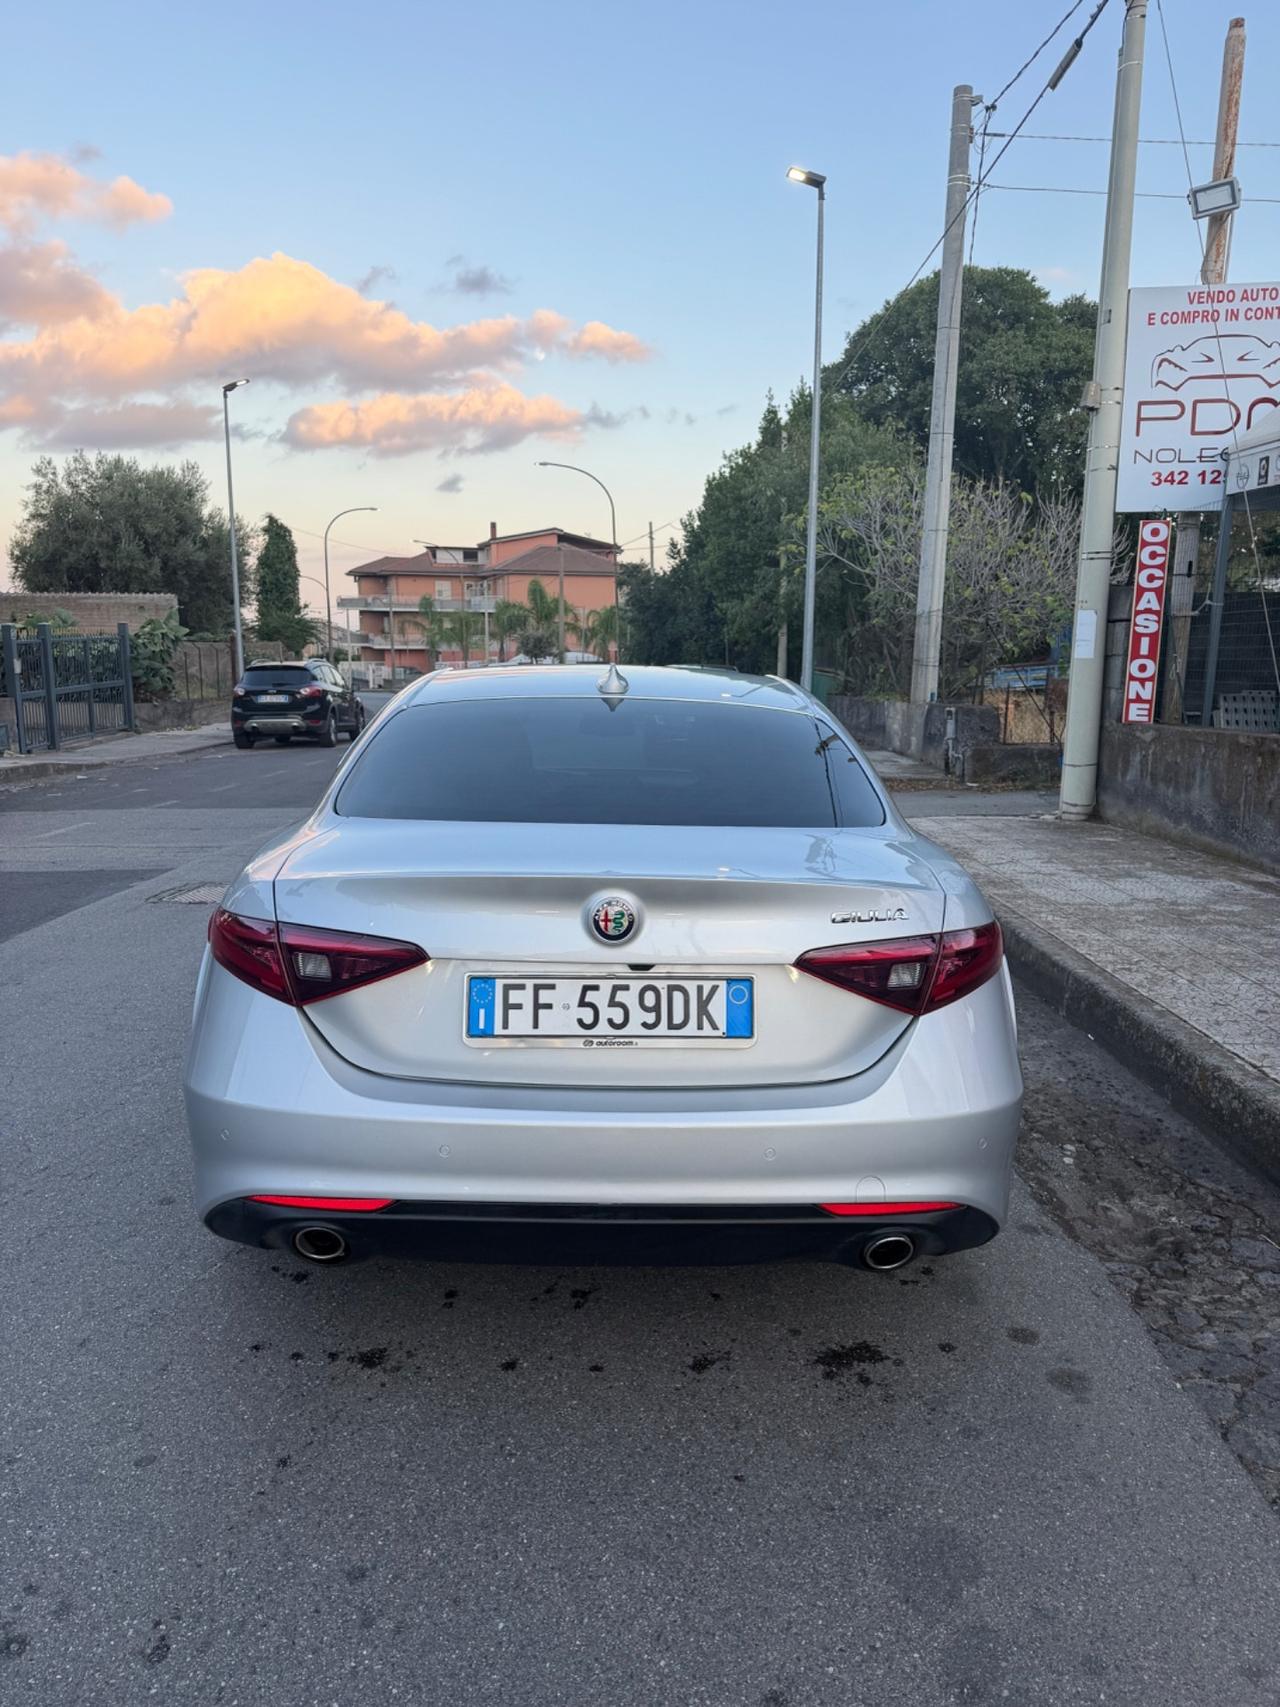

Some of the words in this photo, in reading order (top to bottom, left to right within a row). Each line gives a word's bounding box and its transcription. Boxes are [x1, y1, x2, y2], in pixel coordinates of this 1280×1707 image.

[1187, 289, 1236, 305] VENDO
[1240, 287, 1280, 302] AUTO
[1147, 312, 1157, 326] E
[1160, 309, 1221, 325] COMPRO
[1225, 308, 1240, 322] IN
[1151, 470, 1189, 486] 342
[1127, 522, 1169, 722] OCCASIONE
[831, 908, 910, 924] GIULIA
[502, 983, 556, 1030] FF
[576, 984, 720, 1031] 559DK
